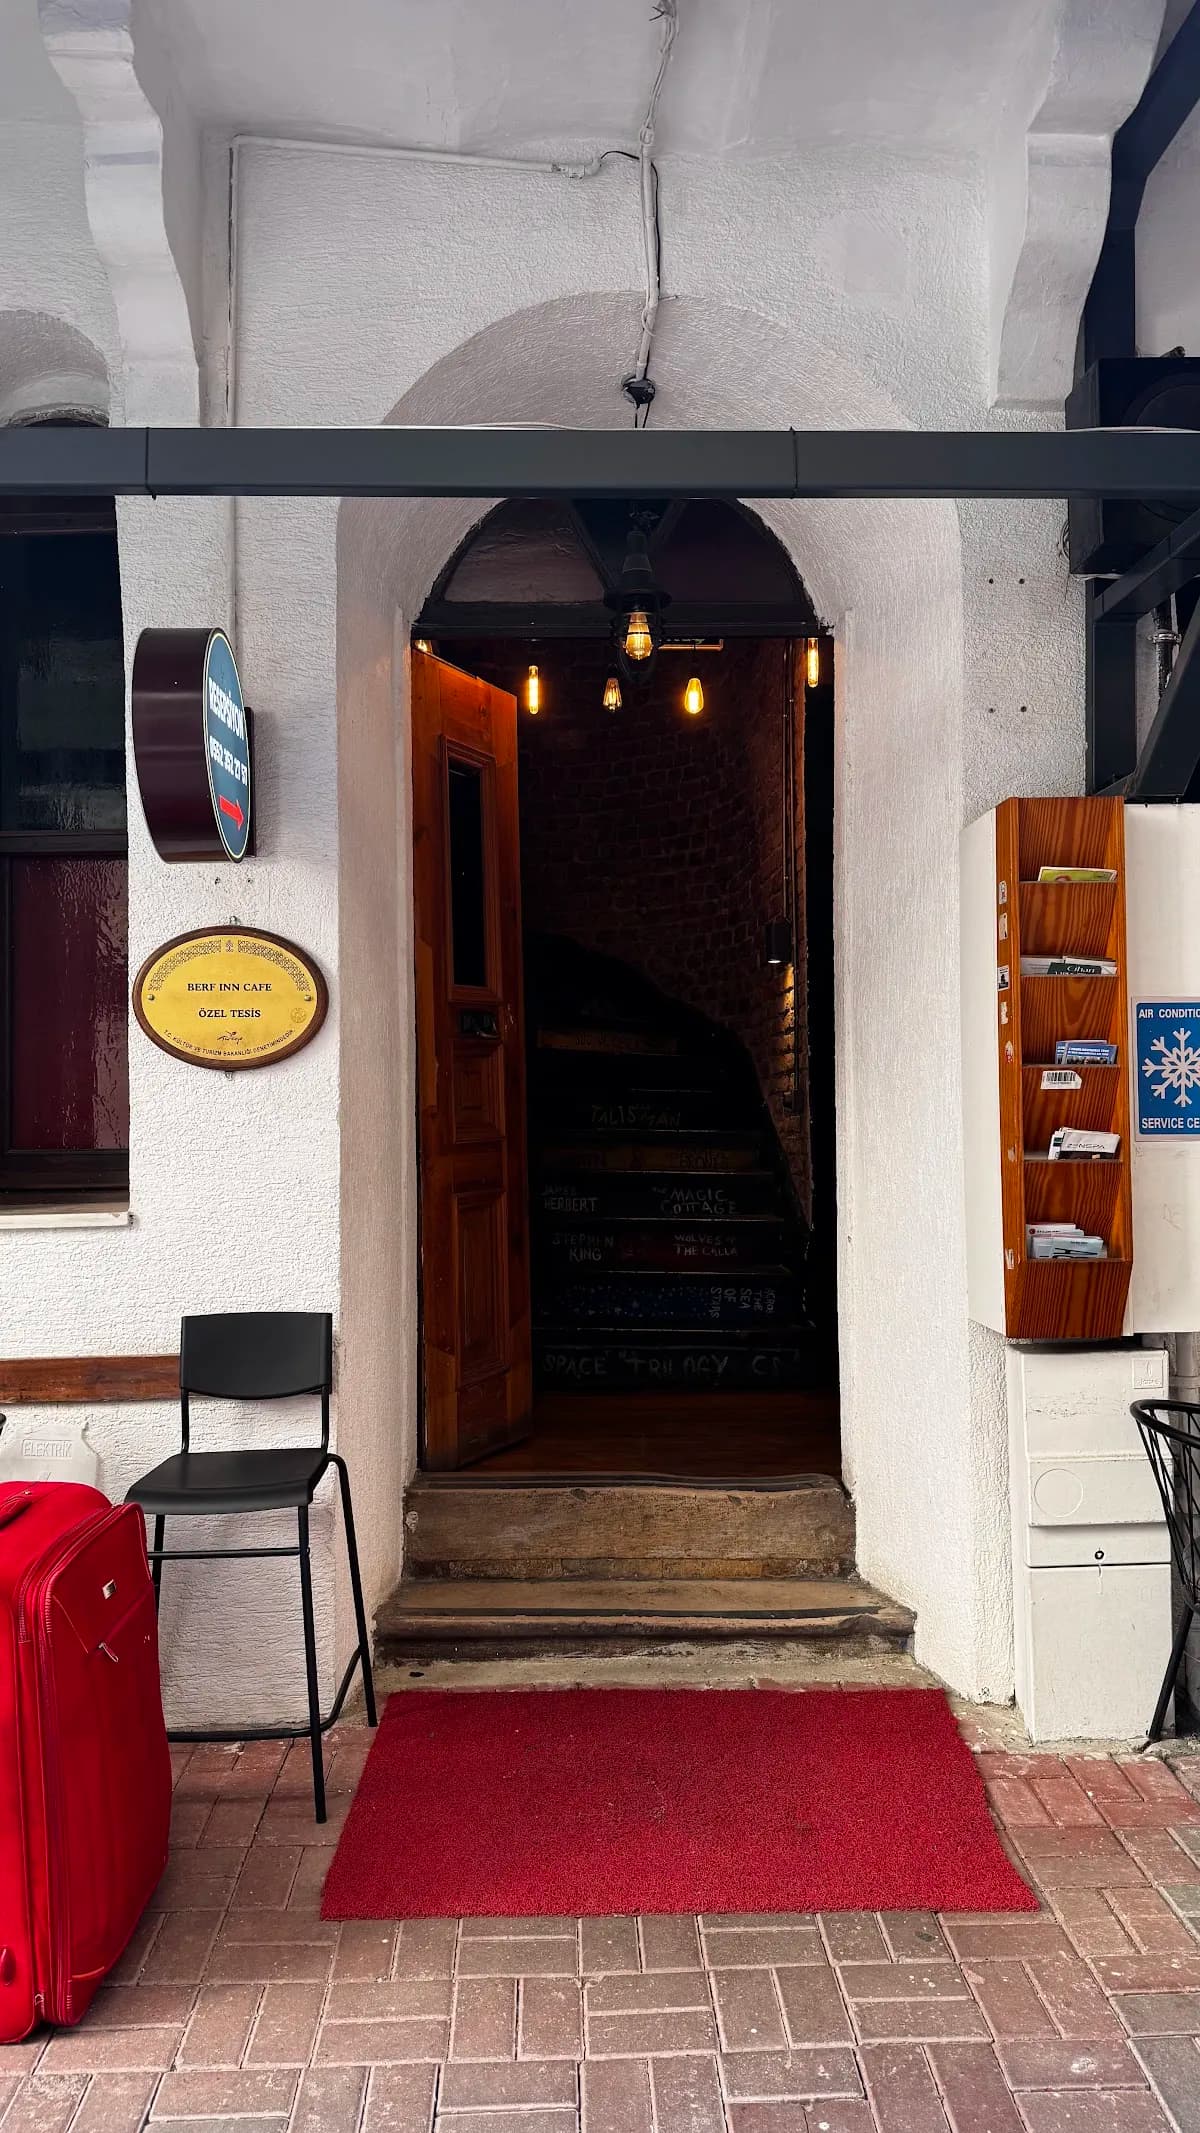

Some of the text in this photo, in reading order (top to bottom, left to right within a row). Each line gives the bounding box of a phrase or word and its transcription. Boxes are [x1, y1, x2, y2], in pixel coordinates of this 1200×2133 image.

[187, 983, 272, 992] BERF INN CAFE
[198, 1008, 261, 1018] ÖZEL TESİS
[1138, 1008, 1154, 1018] AIR
[1141, 1117, 1184, 1129] SERVICE
[670, 1187, 729, 1201] MAGIC
[660, 1200, 737, 1215] COTTAGE
[568, 1248, 603, 1264] KING
[723, 1287, 737, 1303] OF
[738, 1287, 753, 1309] SEA
[709, 1287, 722, 1319] STARS
[543, 1354, 609, 1377] SPACE
